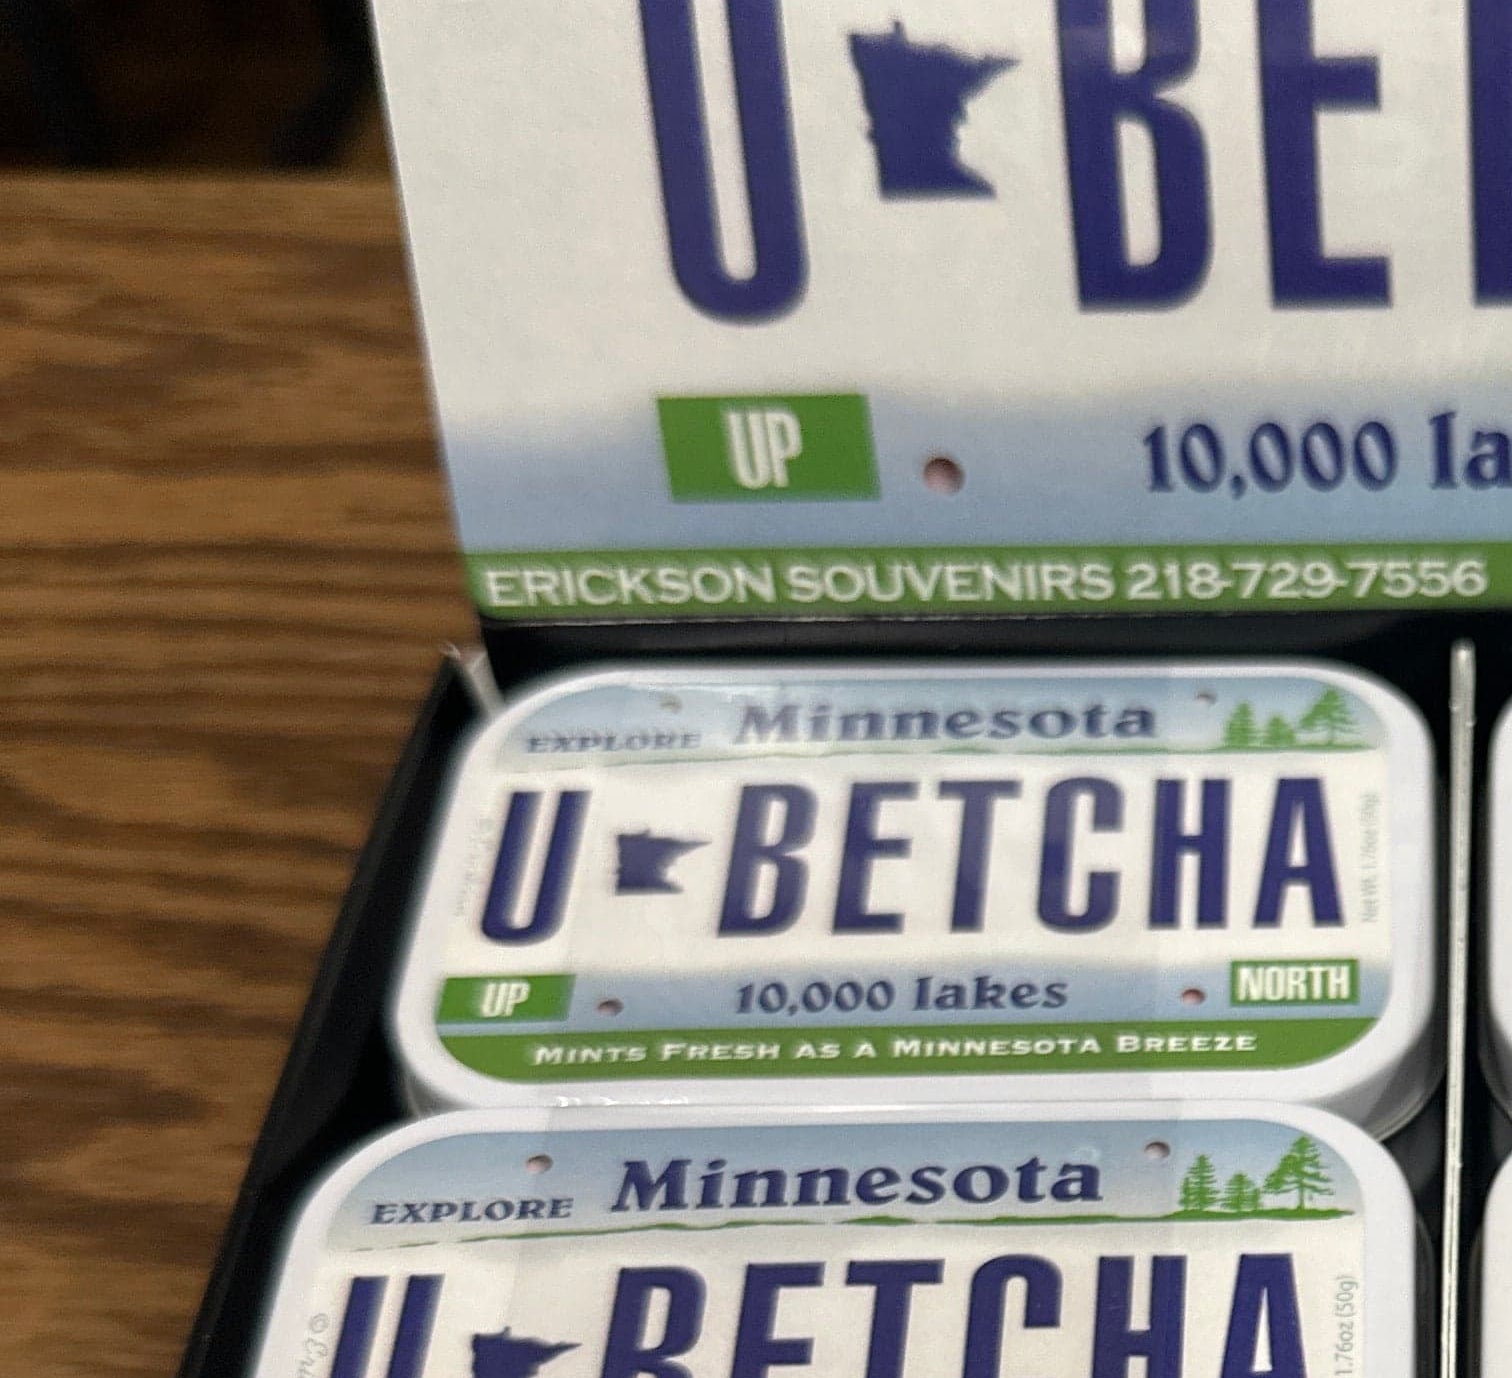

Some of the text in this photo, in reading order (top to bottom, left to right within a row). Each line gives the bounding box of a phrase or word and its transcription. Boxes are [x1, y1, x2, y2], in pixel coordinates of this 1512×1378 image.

[640, 0, 810, 327] U
[723, 406, 802, 490] UP
[1142, 417, 1398, 502] 10,000
[485, 553, 1488, 607] ERICKSON SOUVENIRS 218-729-7556
[528, 701, 1157, 753] EXPLORE Minnesota
[481, 789, 592, 947] U
[717, 777, 1344, 938] BETCHA
[481, 981, 531, 1018] UP
[735, 975, 1068, 1016] 10,000 lakes
[1238, 964, 1350, 1000] NORTH
[369, 1157, 1103, 1225] EXPLORE Minnesota
[1335, 1275, 1356, 1318] (50g)
[1335, 1322, 1354, 1376] 1.76oz
